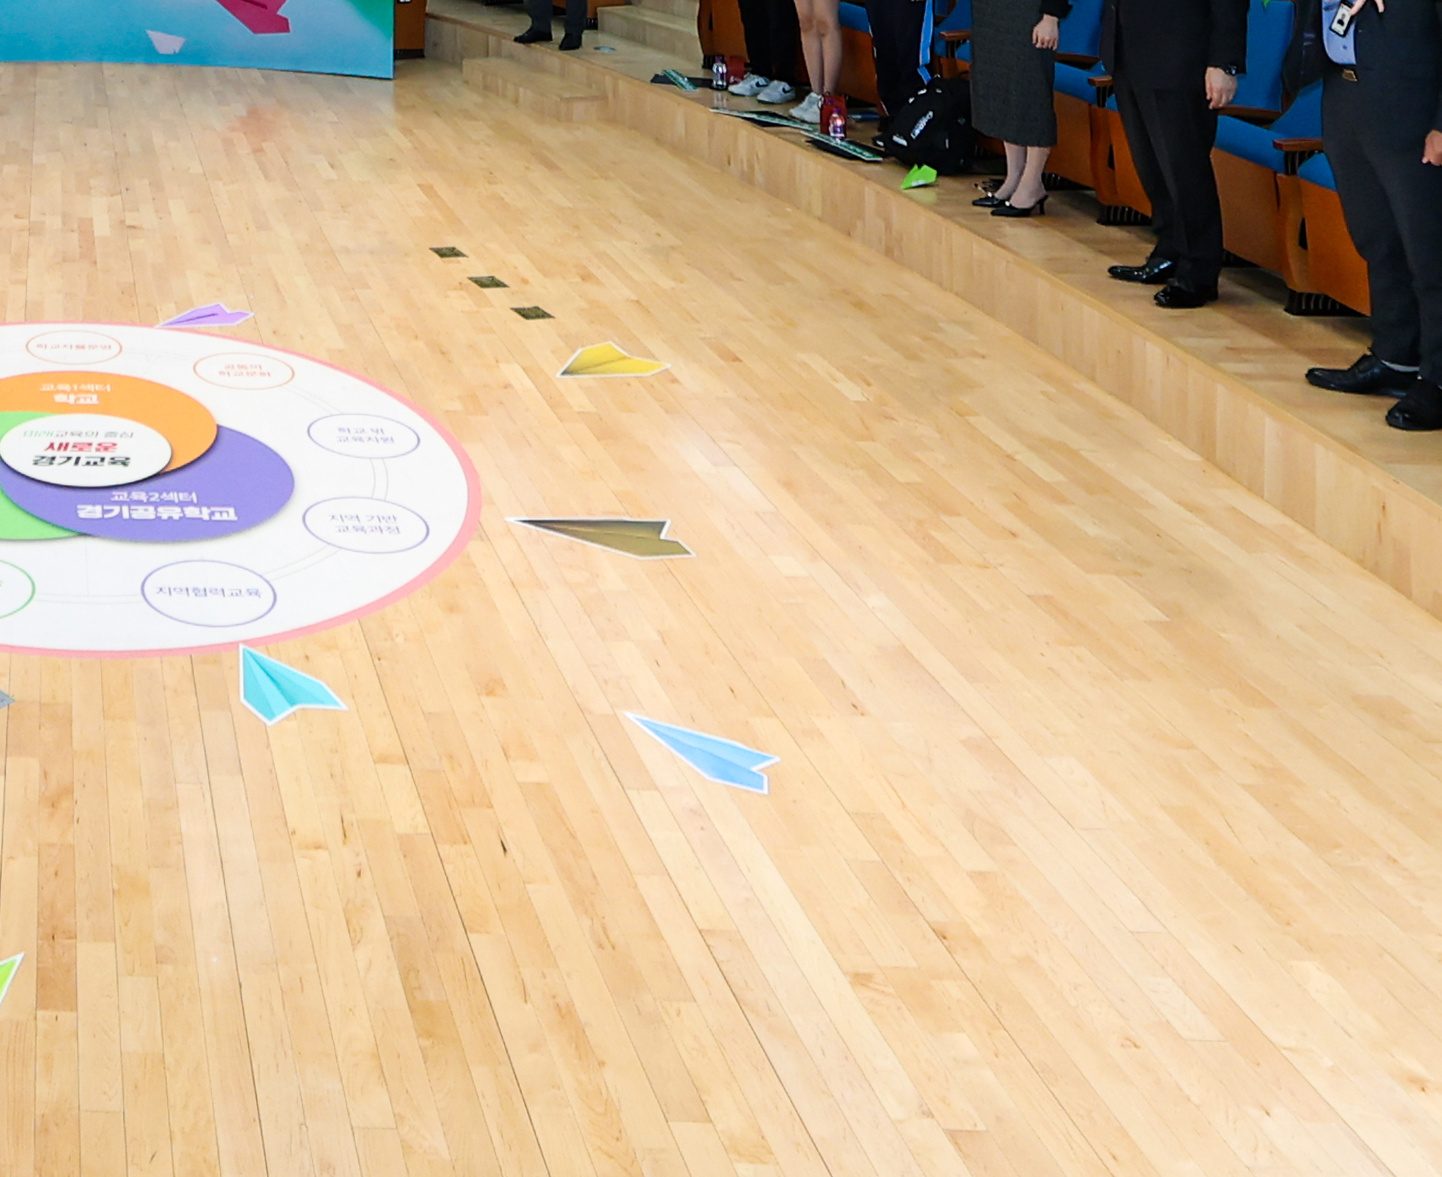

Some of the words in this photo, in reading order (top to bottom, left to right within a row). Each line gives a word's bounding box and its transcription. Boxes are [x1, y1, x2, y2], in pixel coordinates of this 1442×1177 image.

[39, 383, 111, 392] 교육1섹터
[53, 394, 100, 405] 학교
[23, 430, 99, 439] 미래교육의
[104, 430, 134, 439] 중심
[338, 427, 362, 435] 학교
[336, 435, 395, 444] 교육지원
[44, 442, 118, 452] 새로운
[32, 455, 131, 467] 경기교육
[111, 491, 198, 503] 교육2섹터
[76, 504, 238, 521] 경기공유학교
[329, 513, 360, 523] 지역
[366, 514, 398, 523] 기반
[335, 525, 401, 535] 교육과정
[155, 586, 262, 600] 지역협력교육
